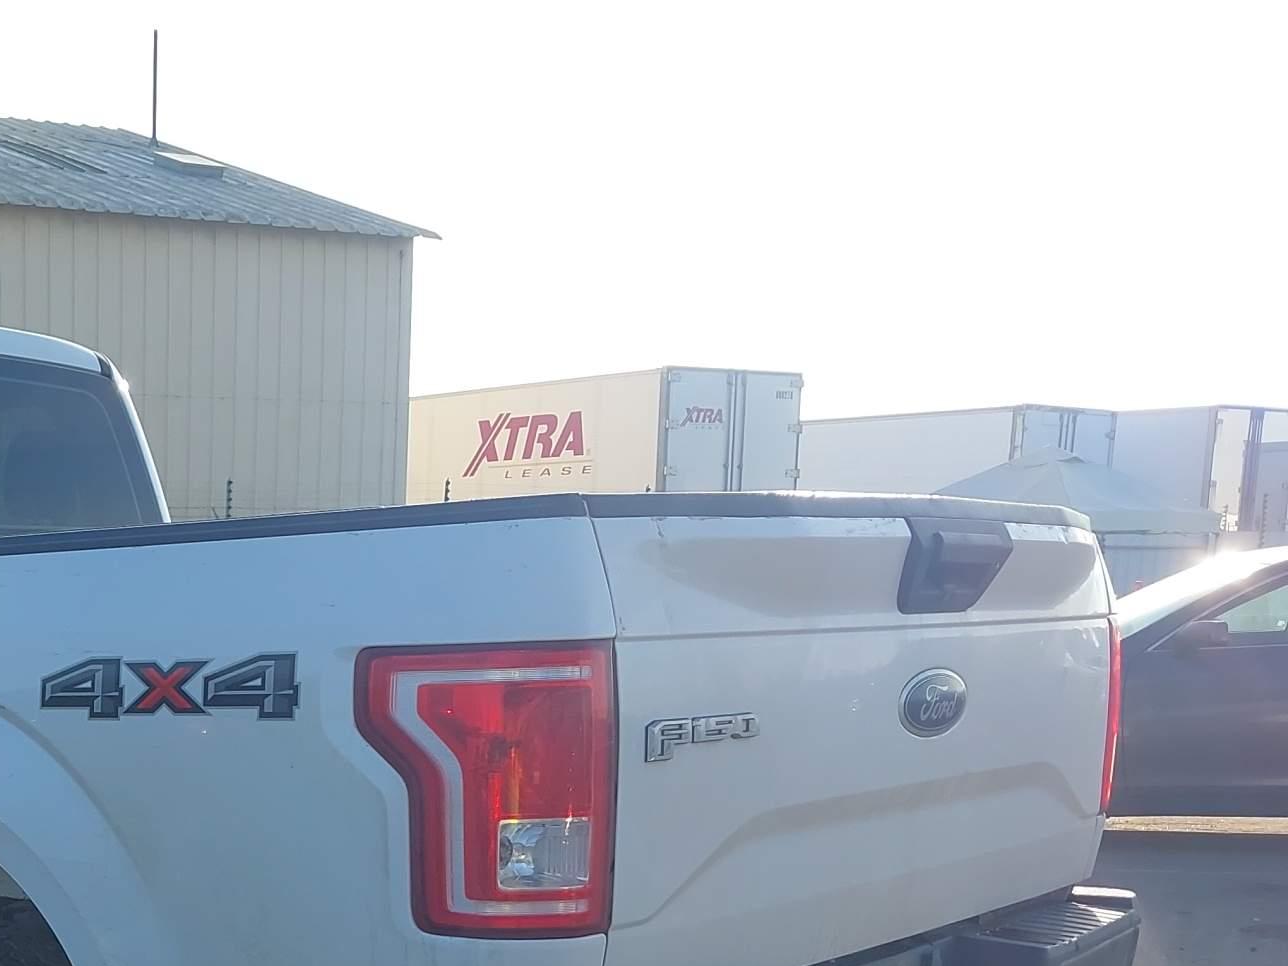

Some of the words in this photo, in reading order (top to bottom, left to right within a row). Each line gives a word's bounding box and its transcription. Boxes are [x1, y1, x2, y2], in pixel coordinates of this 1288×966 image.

[679, 406, 723, 427] XTRA
[462, 410, 584, 477] XTRA
[504, 465, 592, 479] LEASE
[920, 684, 958, 720] Ford
